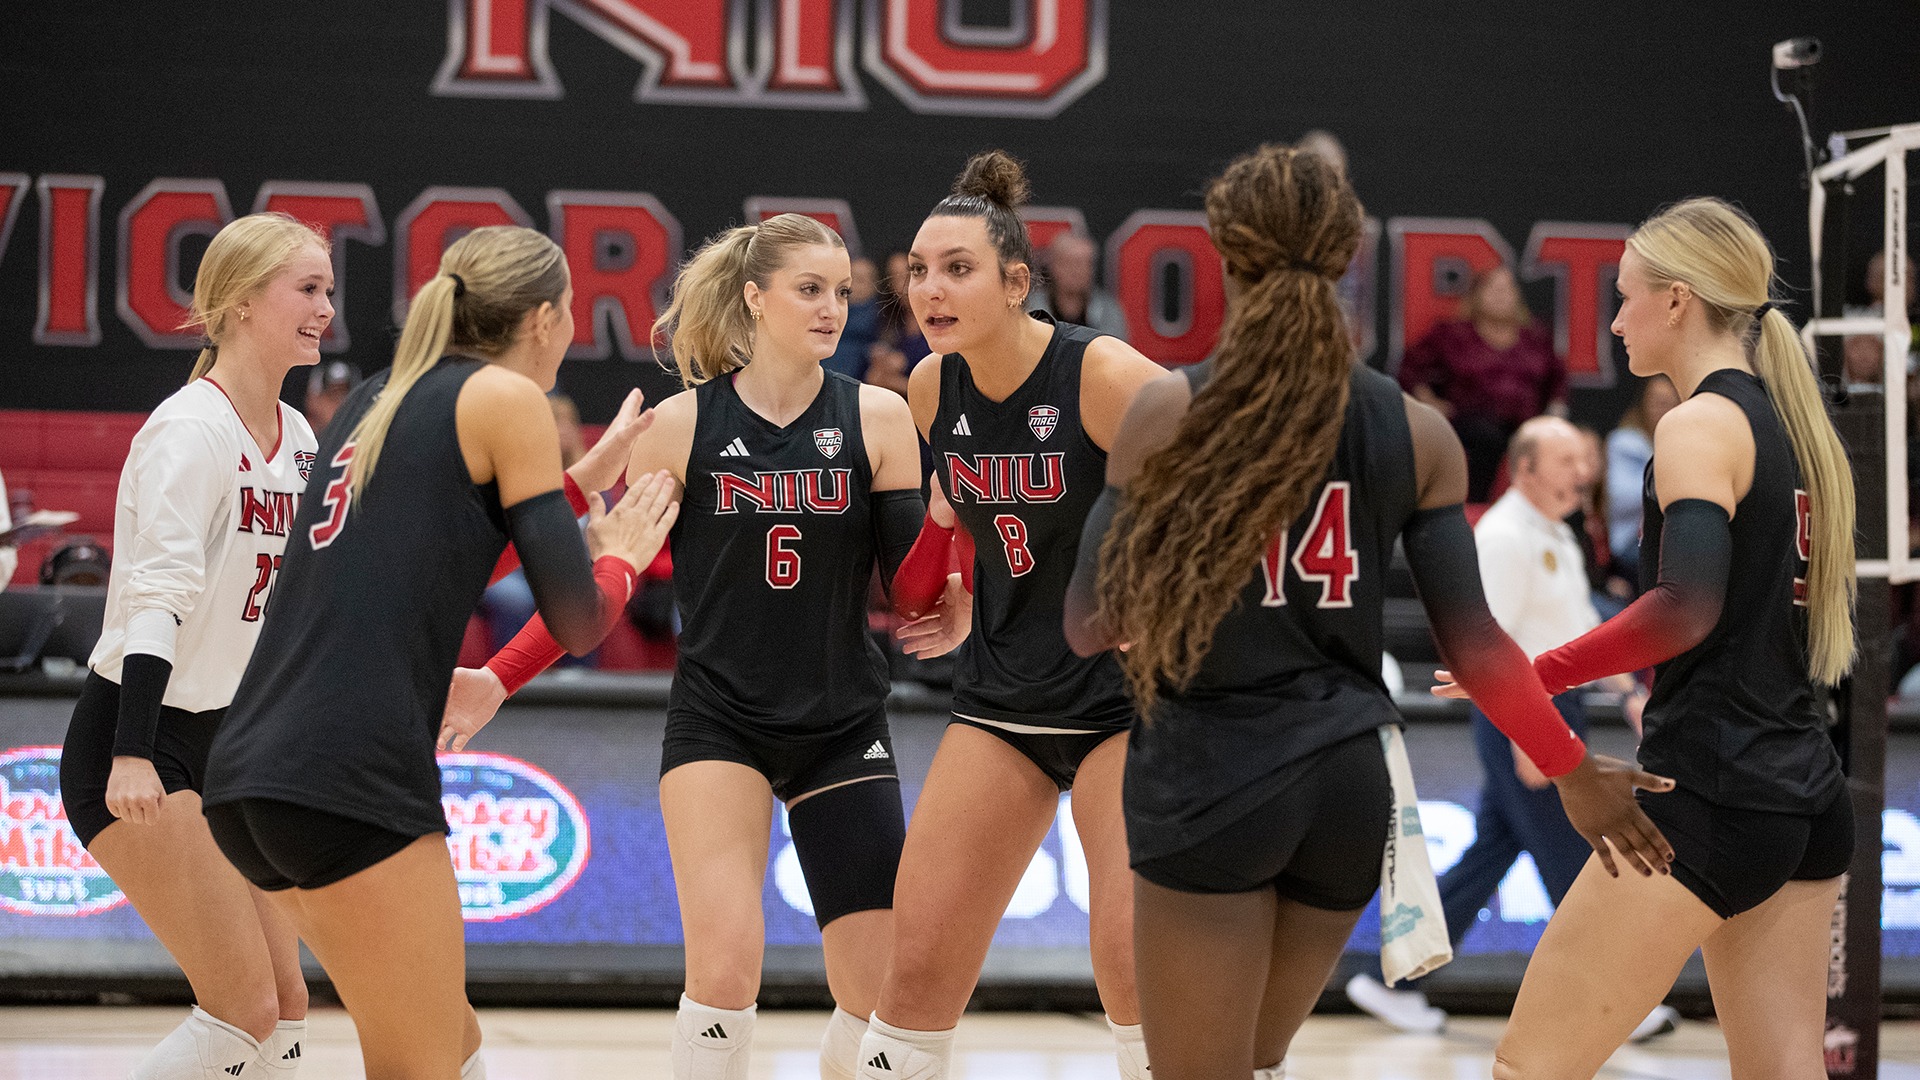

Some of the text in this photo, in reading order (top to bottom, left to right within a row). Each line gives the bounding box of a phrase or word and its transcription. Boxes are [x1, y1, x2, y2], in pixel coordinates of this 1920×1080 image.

[817, 437, 840, 447] MAC
[1030, 416, 1056, 426] MAC
[309, 442, 354, 550] 3
[711, 468, 852, 515] NIU
[944, 451, 1067, 504] NIU
[765, 524, 802, 590] 6
[993, 514, 1036, 578] 8
[1260, 480, 1360, 608] 14
